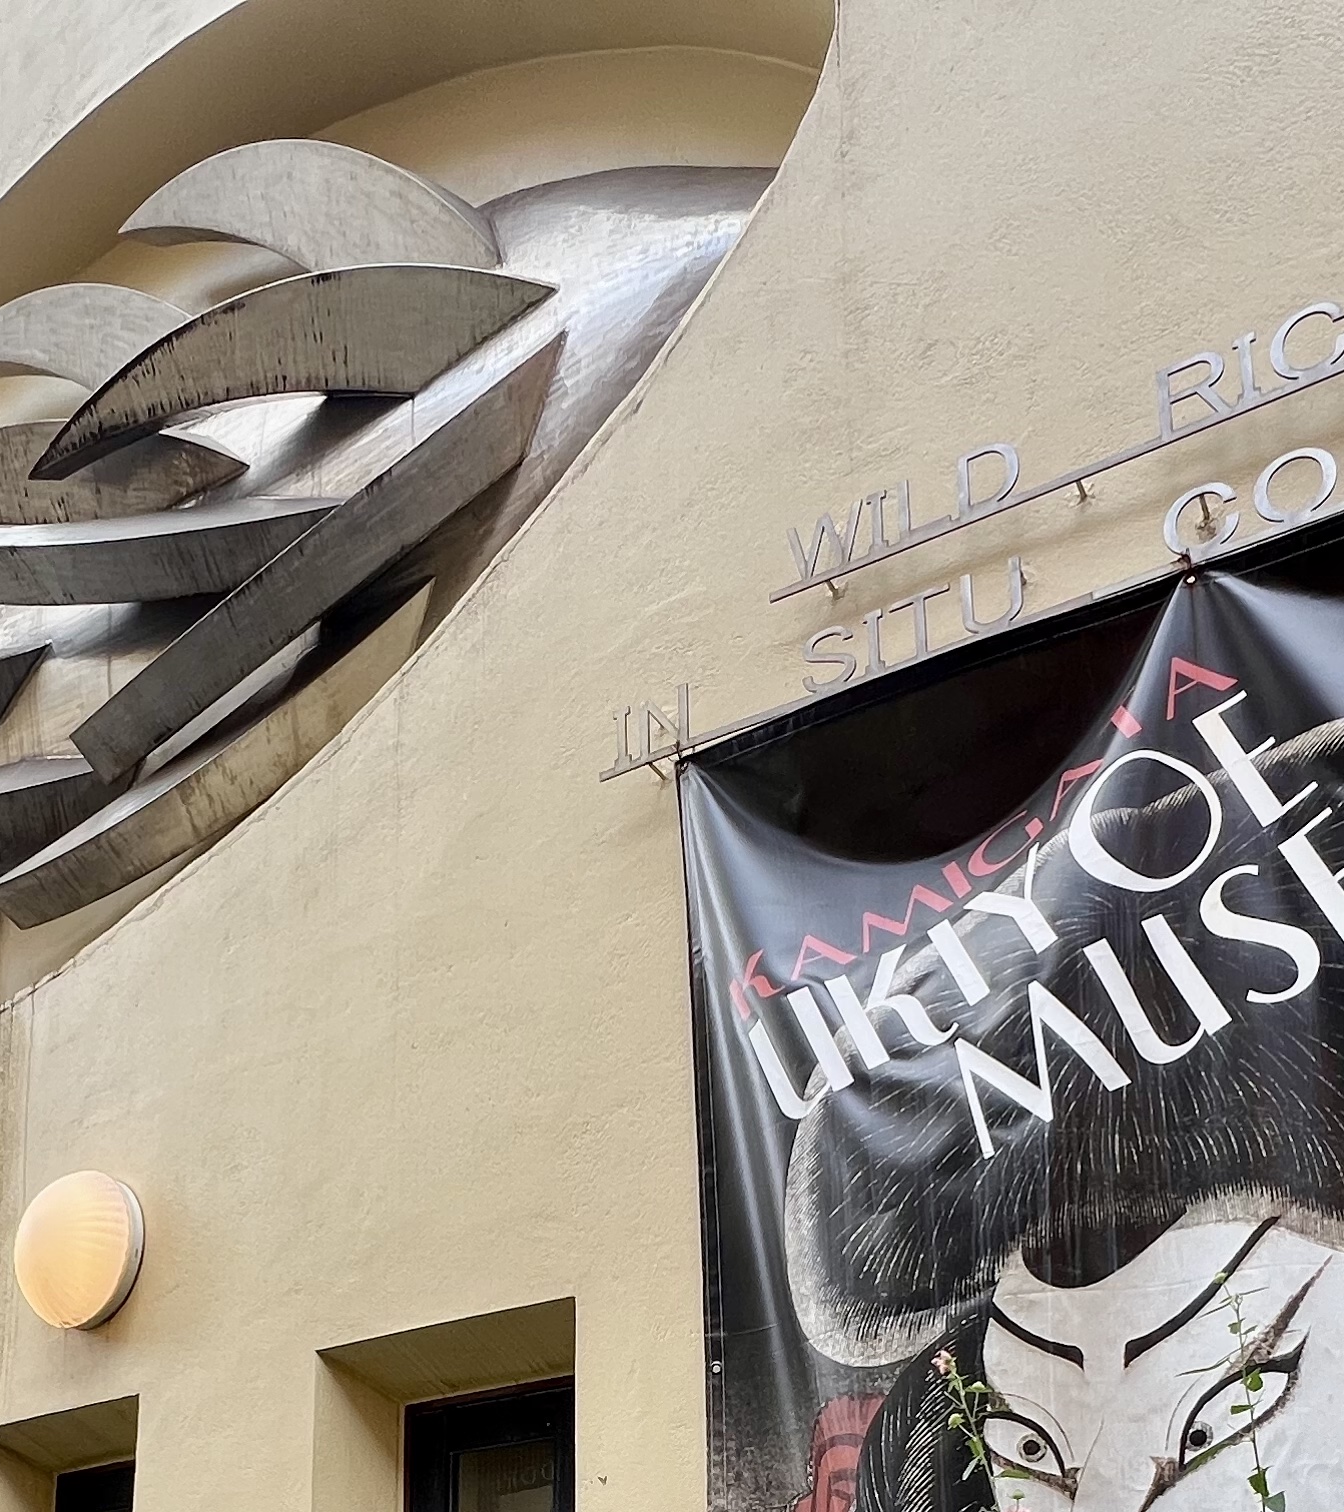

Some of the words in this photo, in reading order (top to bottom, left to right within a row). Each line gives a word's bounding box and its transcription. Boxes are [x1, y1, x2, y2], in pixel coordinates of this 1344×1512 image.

[786, 442, 1022, 582] WILD
[612, 682, 690, 771] IN
[801, 556, 1024, 695] SITU
[729, 656, 1239, 1022] KAMIGAA
[747, 690, 1320, 1121] UKIYOE
